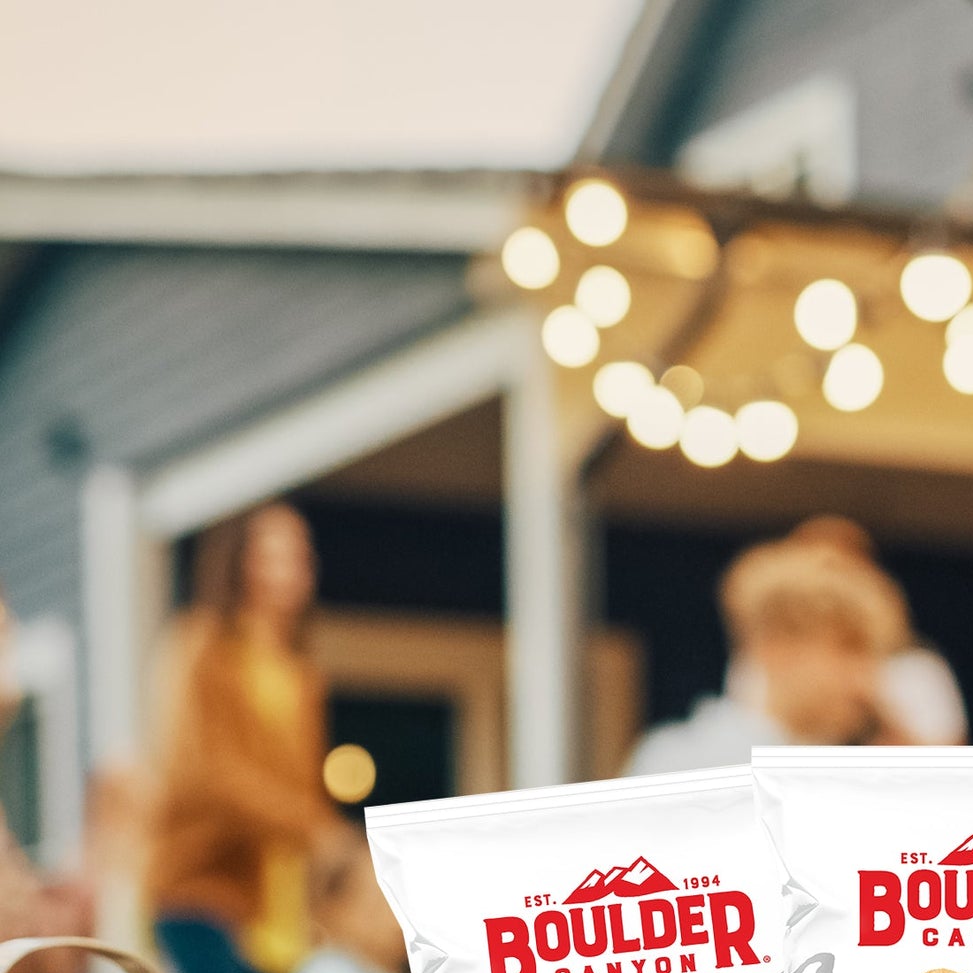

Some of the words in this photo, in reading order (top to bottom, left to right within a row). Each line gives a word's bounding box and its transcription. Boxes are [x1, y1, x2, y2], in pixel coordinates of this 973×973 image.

[900, 852, 933, 865] EST.
[683, 874, 721, 890] 1994
[524, 893, 557, 909] EST.
